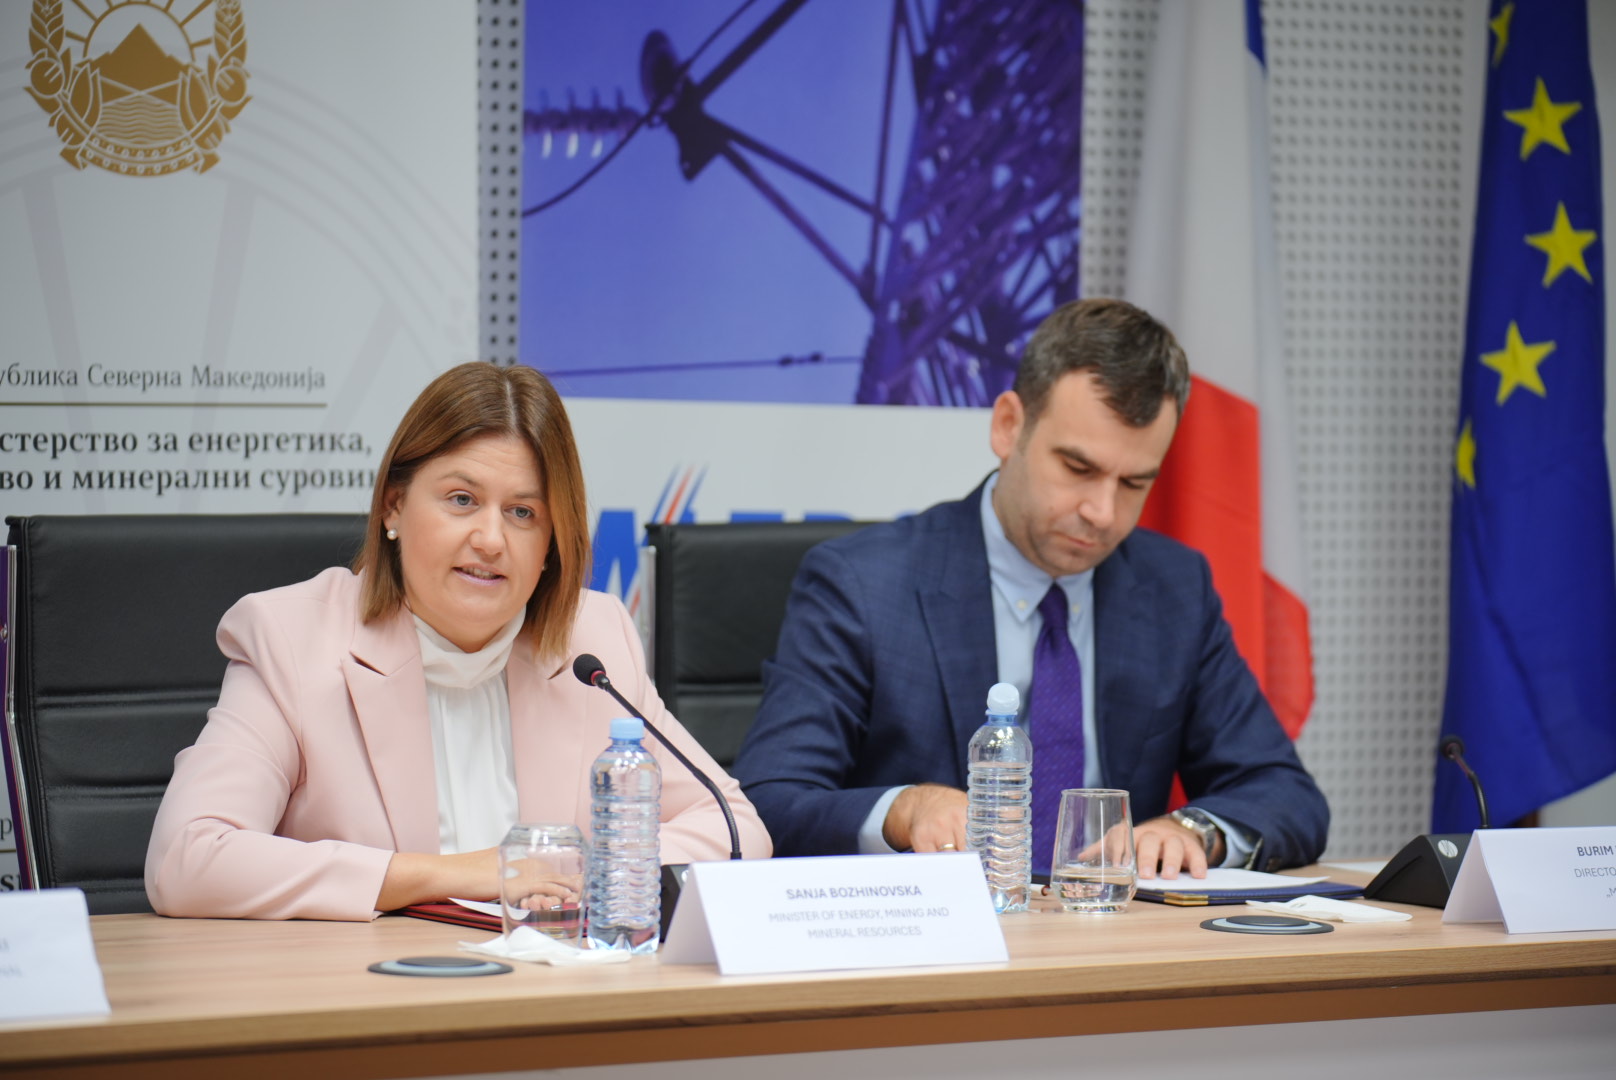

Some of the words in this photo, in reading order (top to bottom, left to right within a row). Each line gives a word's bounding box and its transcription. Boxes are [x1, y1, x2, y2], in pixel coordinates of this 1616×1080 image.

[87, 363, 182, 391] Северна
[190, 365, 326, 392] Македонија
[0, 432, 138, 459] стерство
[148, 433, 178, 452] за
[188, 432, 372, 459] енергетика,
[43, 471, 62, 490] и
[72, 470, 250, 495] минерални
[1577, 845, 1614, 856] BURIM
[786, 888, 827, 900] SANJA
[830, 885, 922, 898] BOZHINOVSKA
[769, 911, 818, 923] MINISTER
[822, 911, 834, 921] OF
[839, 910, 883, 920] ENERGY,
[885, 908, 924, 919] MINING
[926, 906, 949, 918] AND
[808, 928, 854, 939] MINERAL
[857, 926, 921, 938] RESOURCES
